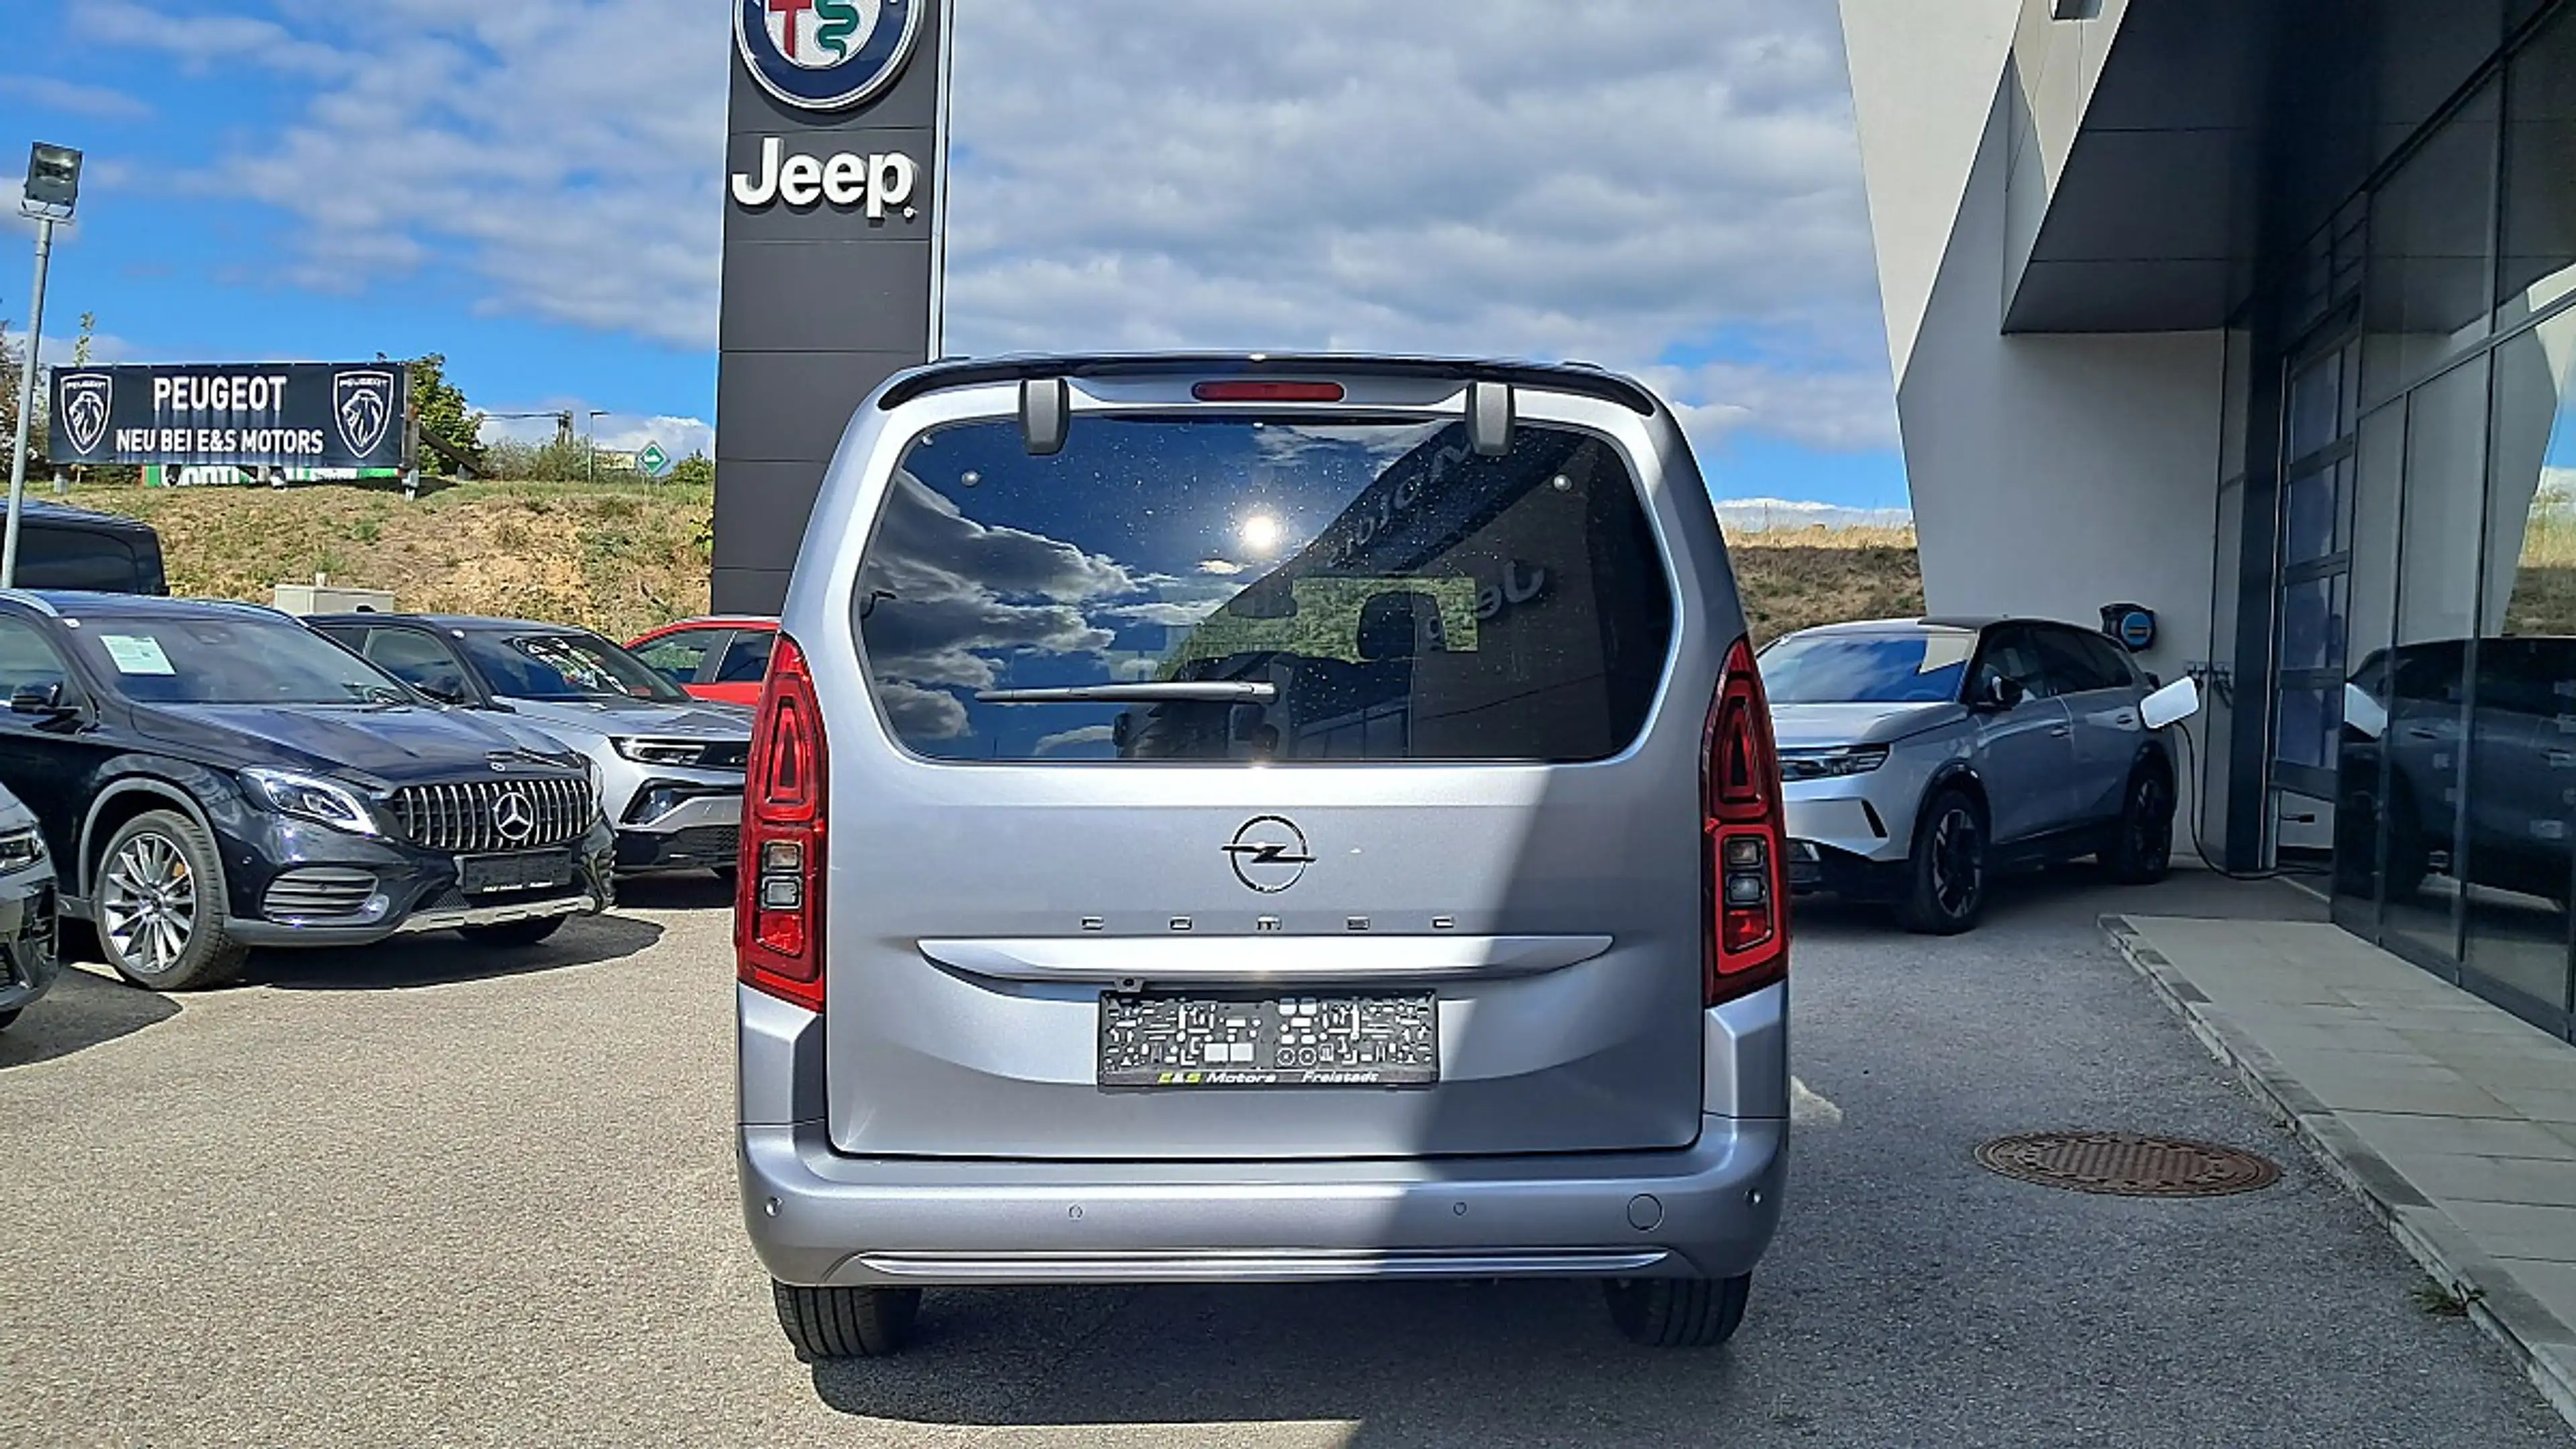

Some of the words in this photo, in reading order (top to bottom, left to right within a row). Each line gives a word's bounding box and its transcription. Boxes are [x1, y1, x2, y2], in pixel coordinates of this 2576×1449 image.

[731, 137, 914, 218] Jeep
[154, 376, 287, 411] PEUGEOT
[115, 429, 156, 452] NEU
[160, 429, 192, 452] BEI
[197, 429, 237, 453] E&S
[240, 429, 324, 454] MOTORS
[1206, 1071, 1277, 1083] Motors
